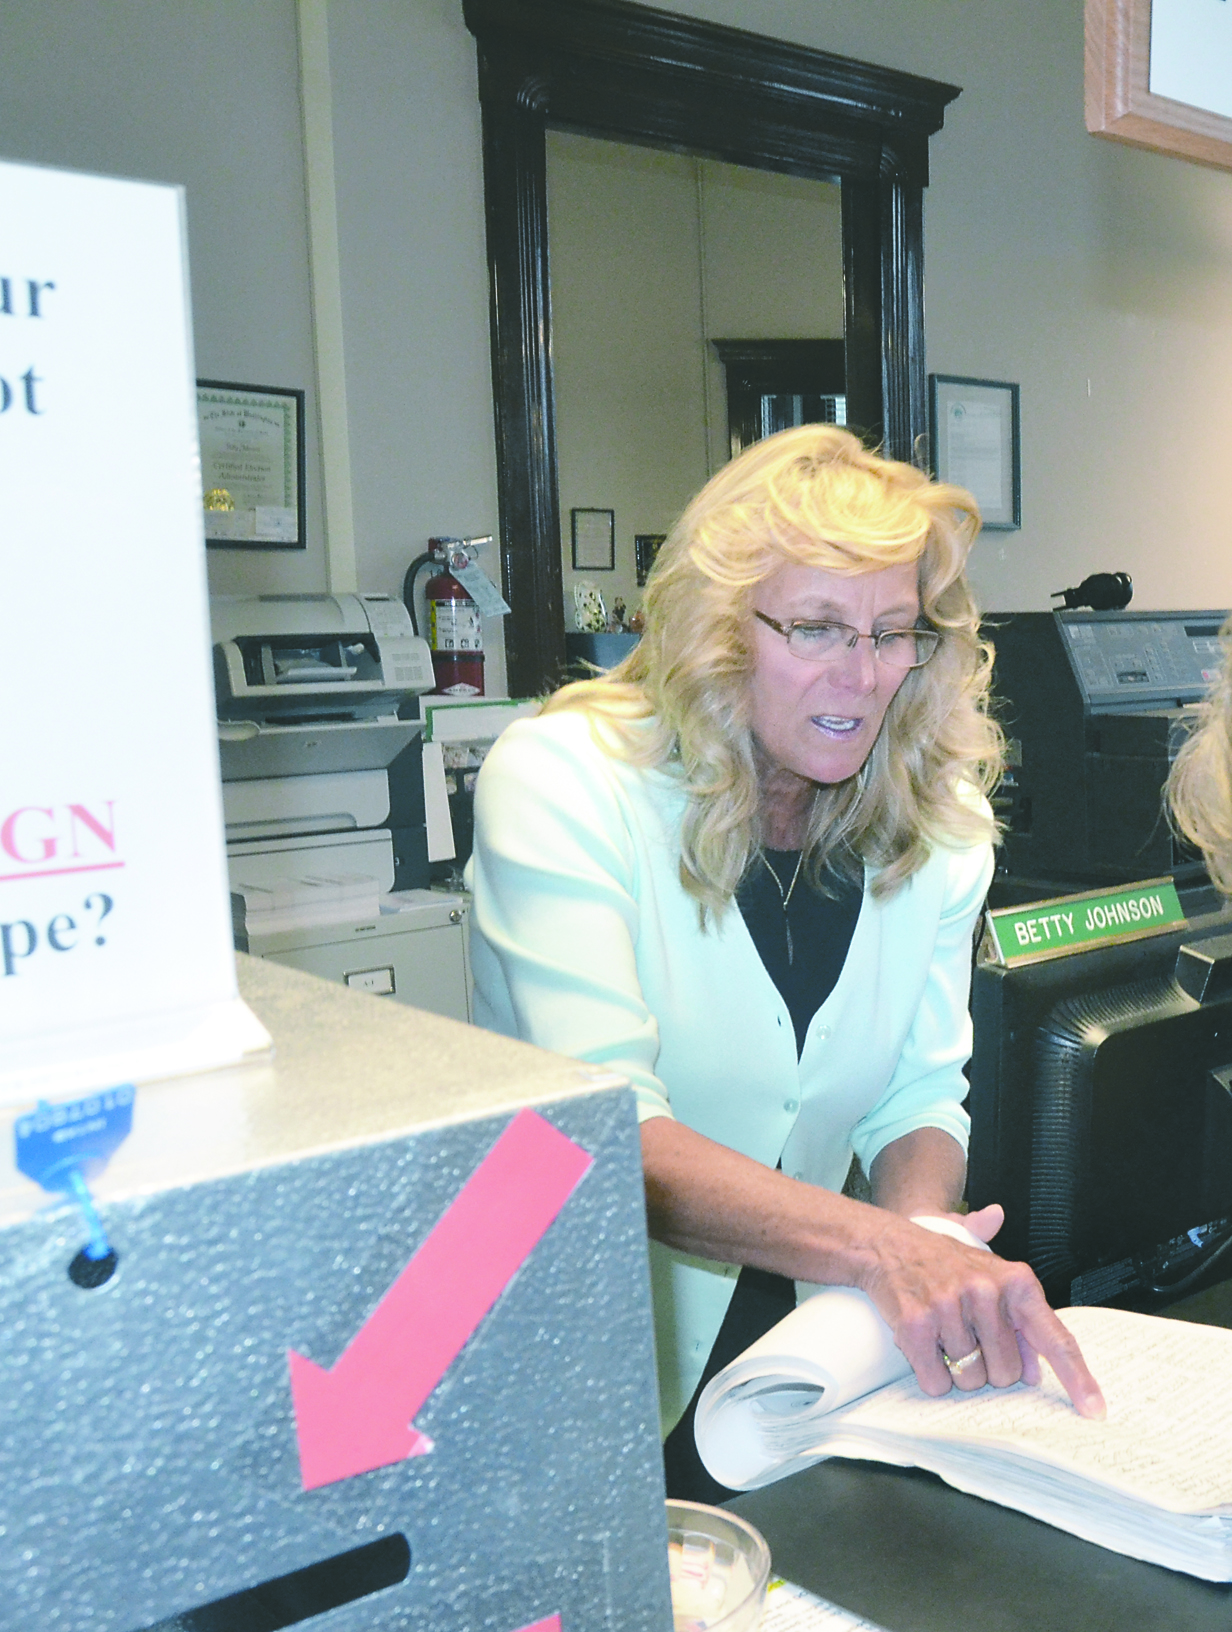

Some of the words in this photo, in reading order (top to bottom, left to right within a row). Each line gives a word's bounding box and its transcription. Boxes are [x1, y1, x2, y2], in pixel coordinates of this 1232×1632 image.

[0, 800, 116, 864] GN
[0, 892, 114, 976] pe?
[1014, 911, 1075, 946] BETTY
[1085, 894, 1164, 931] JOHNSON
